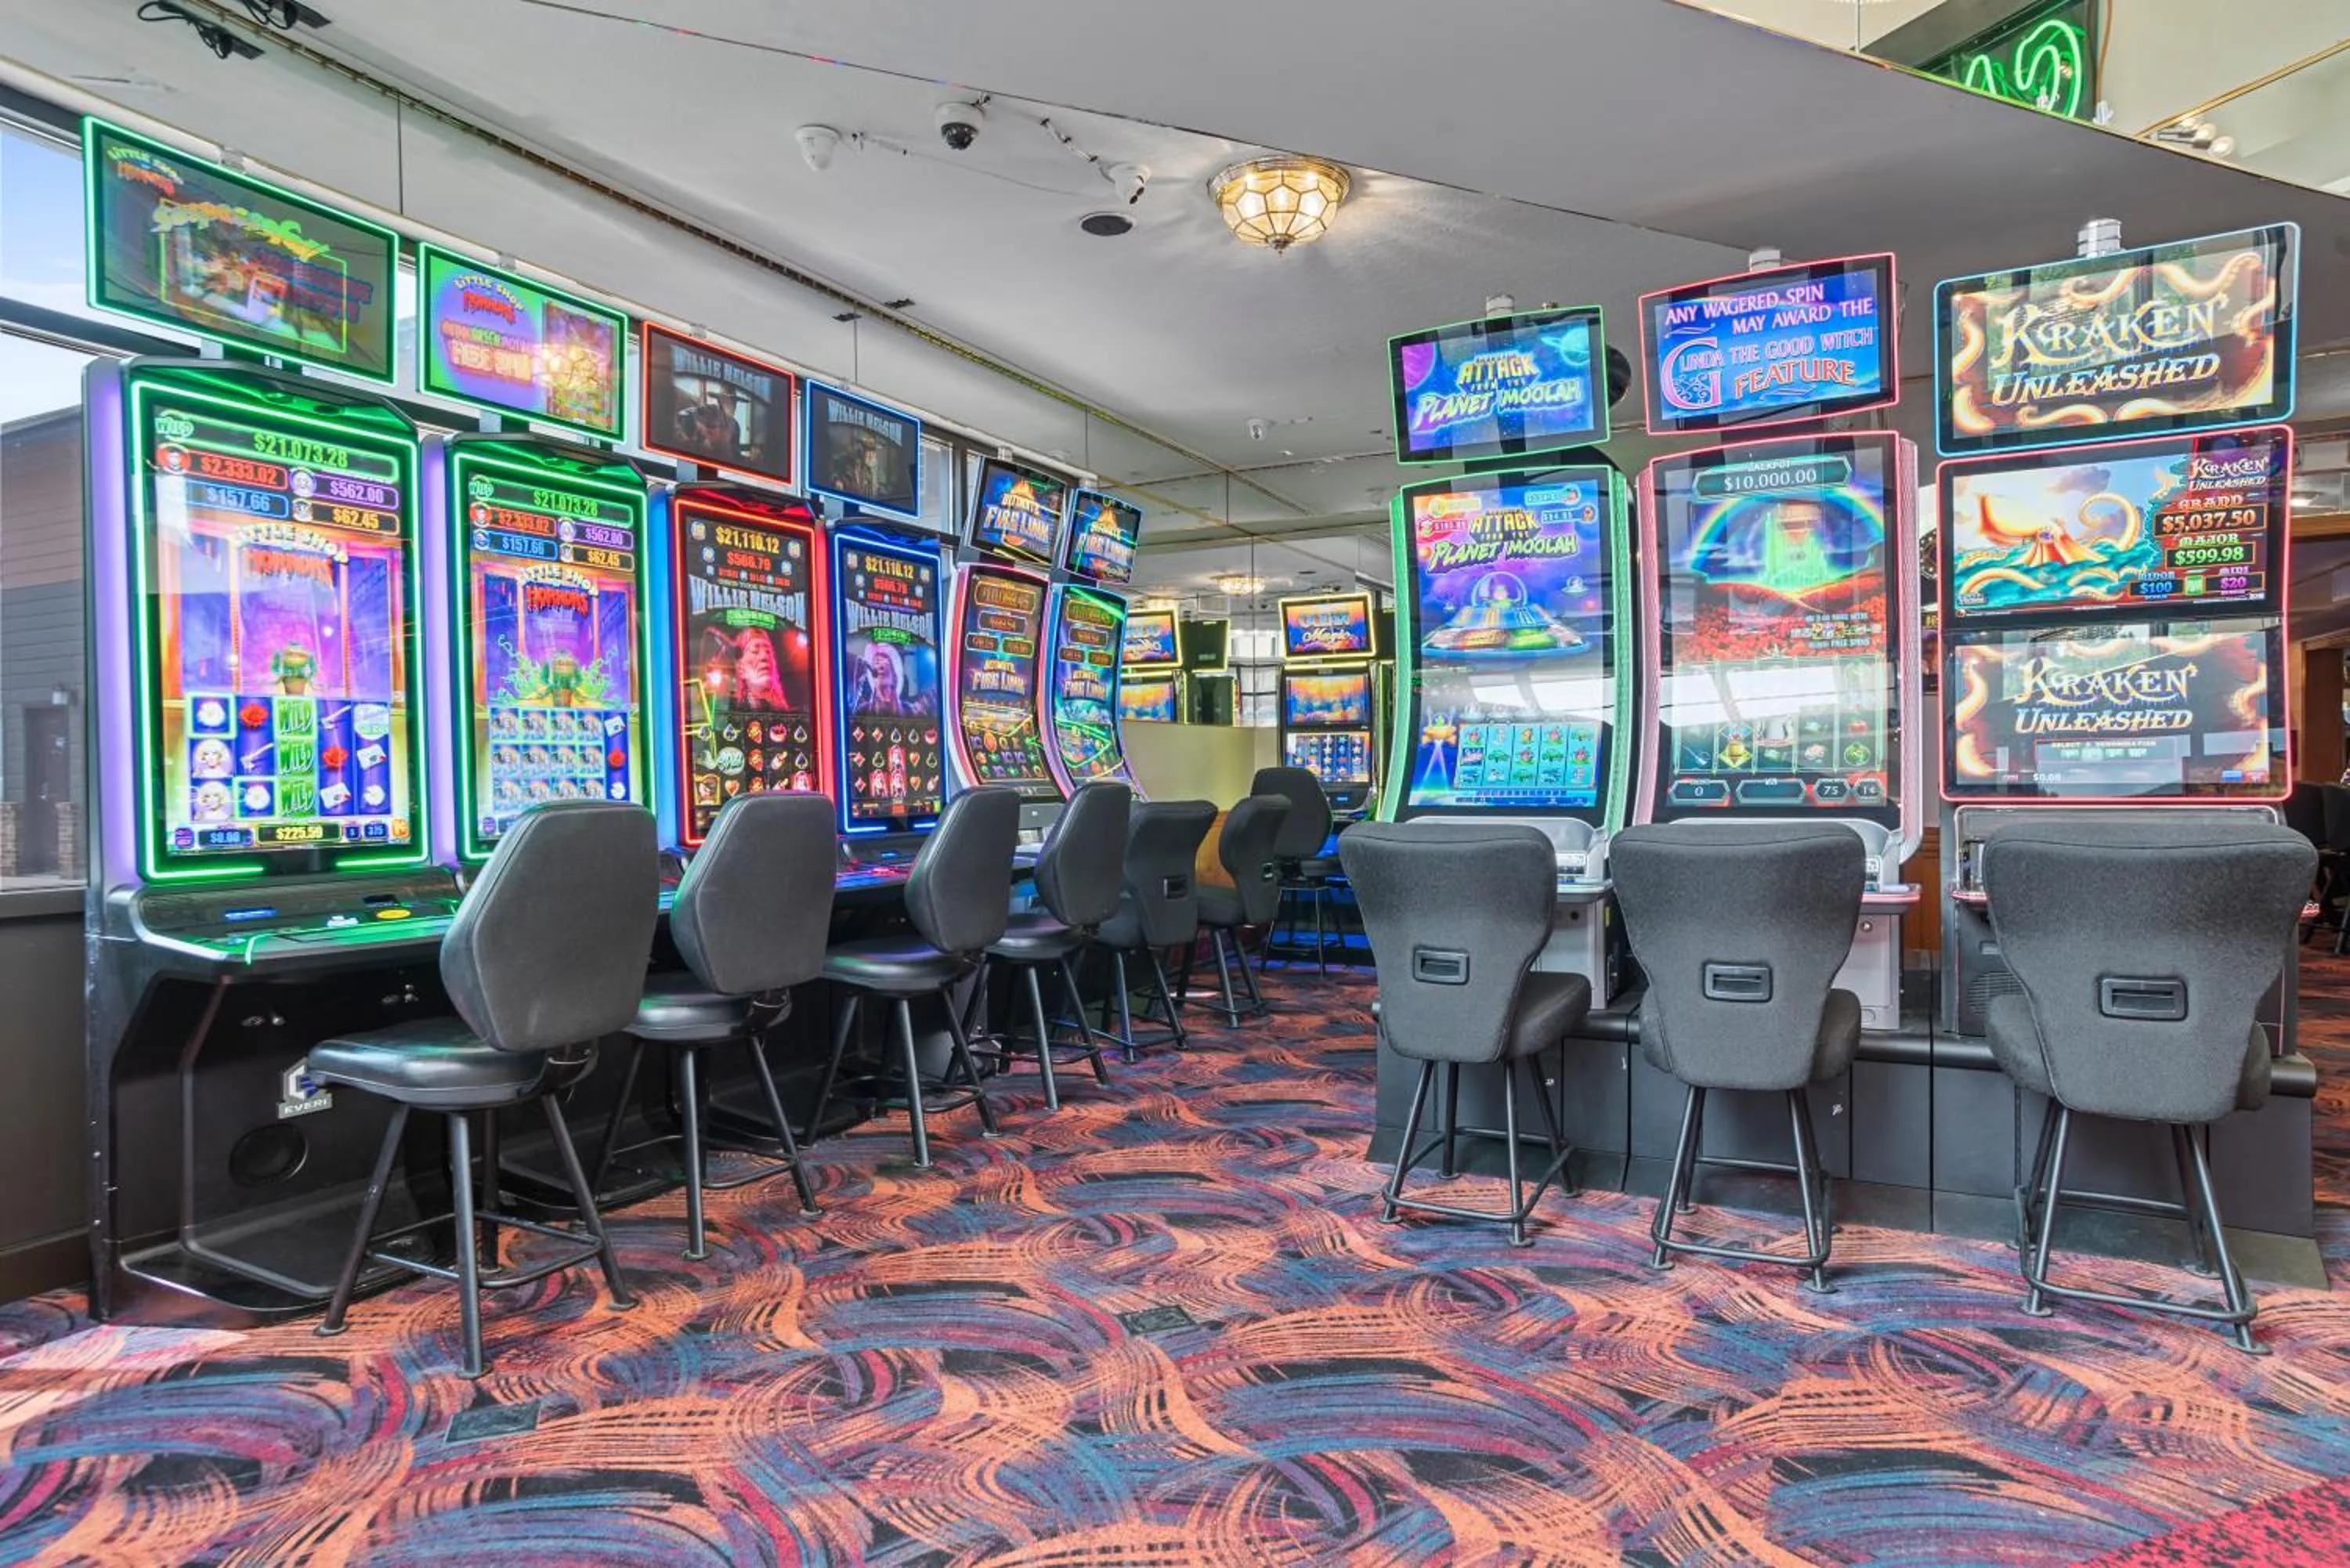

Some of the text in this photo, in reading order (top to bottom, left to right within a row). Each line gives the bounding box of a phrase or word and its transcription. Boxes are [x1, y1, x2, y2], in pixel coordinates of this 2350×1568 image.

[454, 275, 493, 290] LITTLE
[1665, 284, 1824, 326] ANY WAGERED SPIN
[1732, 297, 1873, 335] MAY AWARD THE
[1990, 290, 2229, 368] KRAKEN
[1730, 343, 1762, 366] THE
[1764, 334, 1814, 360] GOOD
[1820, 327, 1874, 351] WITCH
[670, 345, 772, 403] WILLIE NELSON
[1459, 354, 1539, 385] ATTACK
[1734, 358, 1856, 401] FEATURE
[1990, 352, 2221, 407] UNLEASHED
[1411, 378, 1581, 432] PLANET MOOLAH
[826, 397, 902, 447] WILLIE NELSON
[2191, 456, 2269, 479] KRAKEN
[333, 508, 380, 529] $62.45
[2178, 494, 2244, 511] GRAND
[1470, 511, 1538, 533] ATTACK
[1428, 534, 1578, 573] PLANET MOOLAH
[2174, 545, 2244, 566] $599.98
[2139, 581, 2173, 594] $100
[2220, 576, 2247, 590] $20
[689, 573, 748, 615] WILLIE
[750, 588, 806, 630] NELSON
[845, 598, 891, 634] WILLIE
[2014, 656, 2199, 706] KRAKEN
[2014, 706, 2194, 735] UNLEASHED
[1694, 786, 1704, 797] 0
[1824, 786, 1838, 796] 75
[284, 1099, 327, 1115] EVERI
